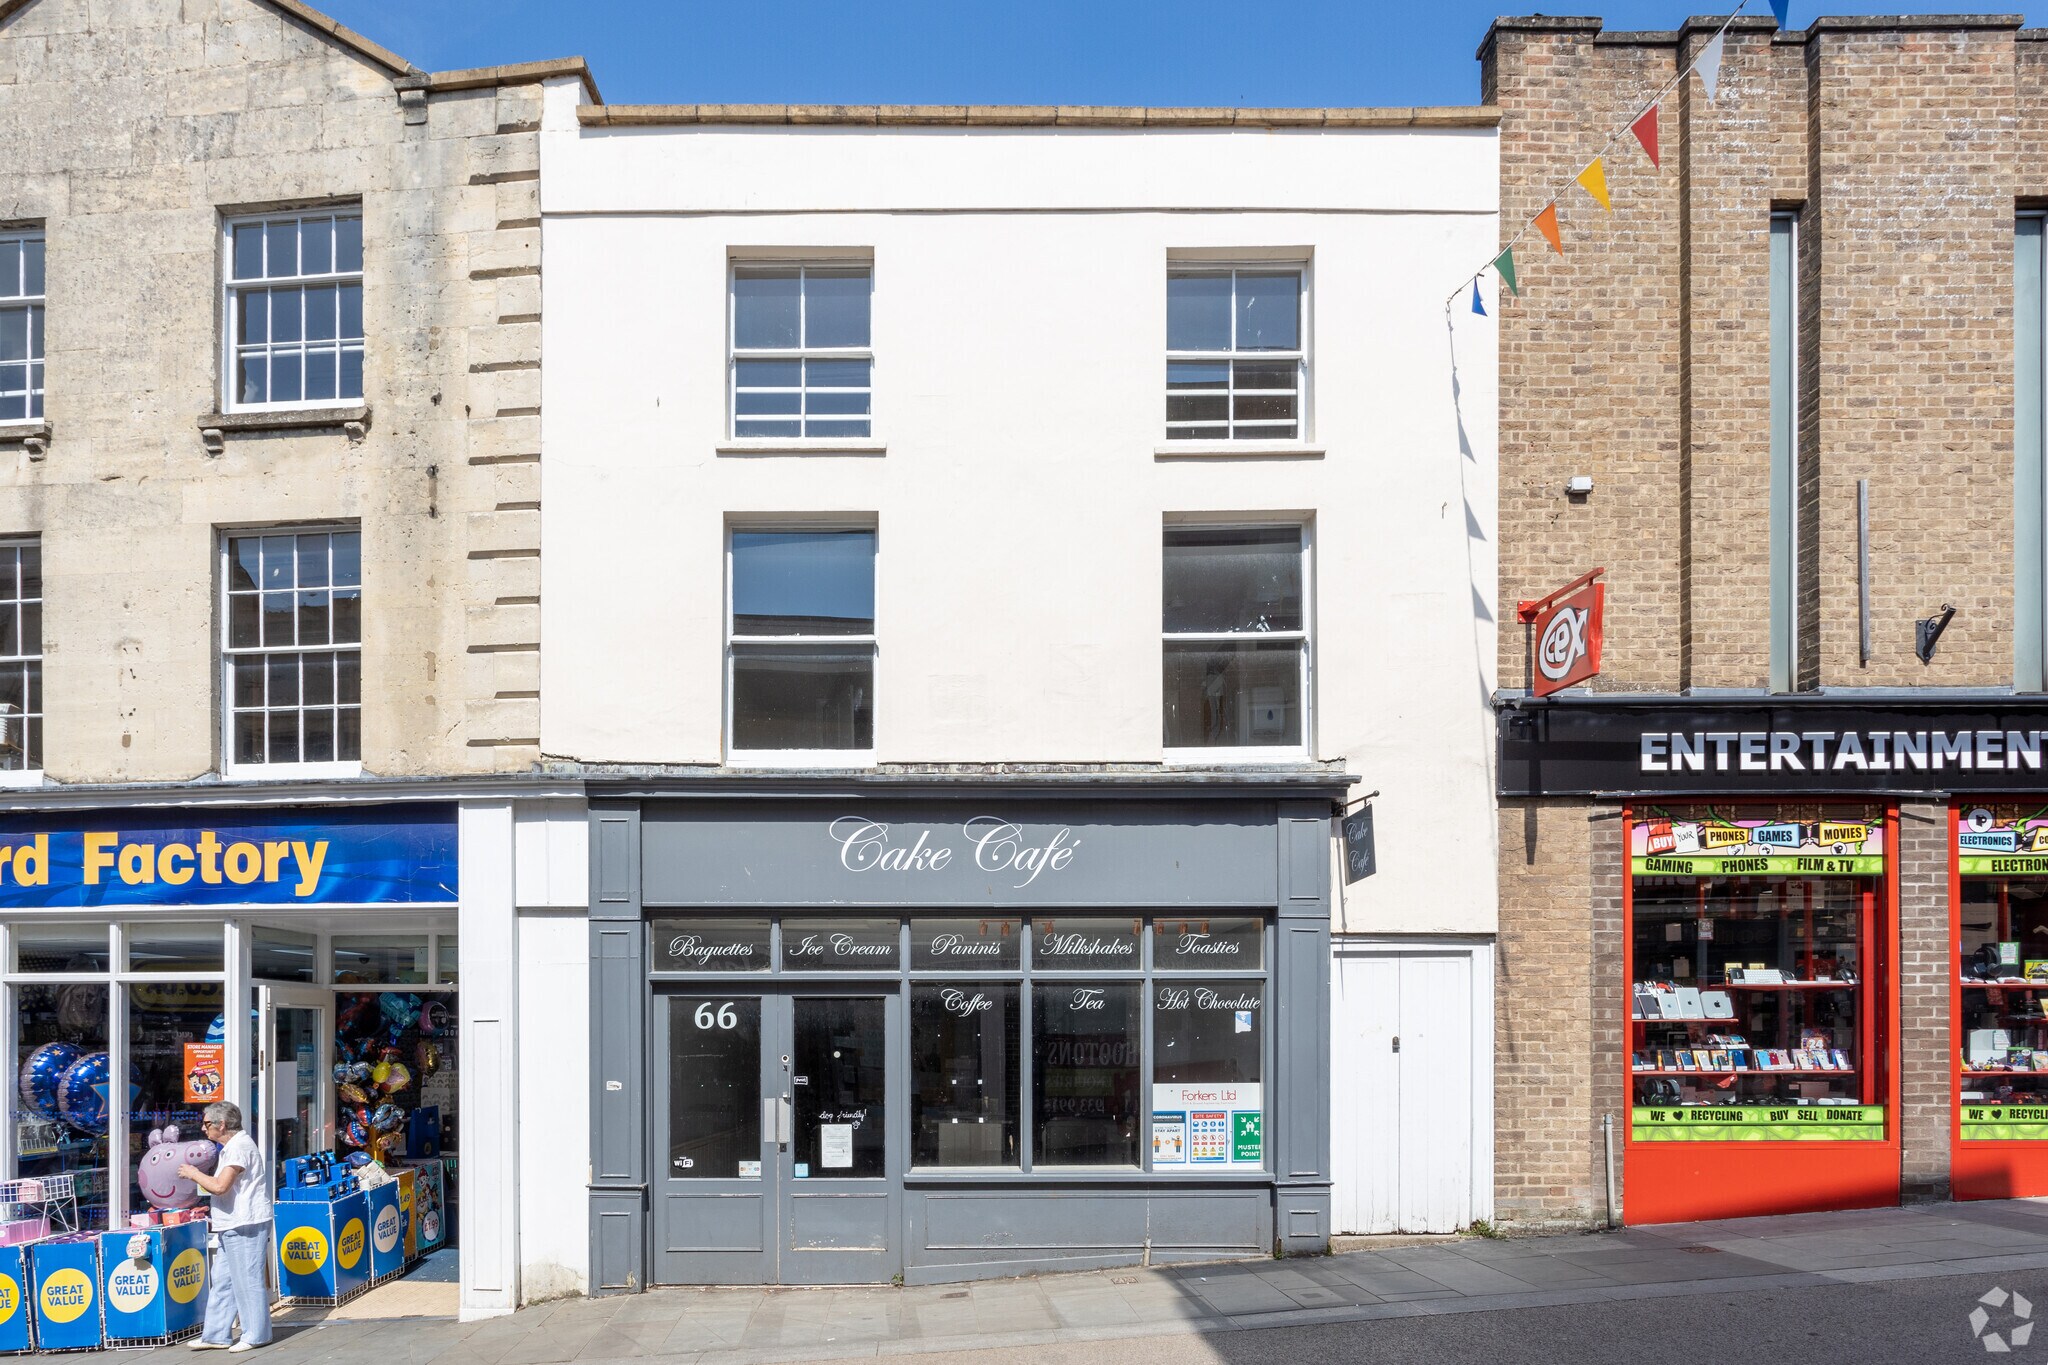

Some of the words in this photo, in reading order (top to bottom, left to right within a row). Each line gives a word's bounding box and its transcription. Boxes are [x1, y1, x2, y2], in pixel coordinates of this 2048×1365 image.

[1641, 731, 2048, 772] ENTERTAINMEN
[1346, 822, 1369, 844] Cake
[1652, 837, 1673, 850] BUY
[1676, 830, 1694, 843] YOUR
[1710, 831, 1746, 843] PHONES
[1758, 830, 1793, 843] GAMES
[1824, 827, 1863, 840] MOVIES
[1960, 835, 2012, 846] ELECTRONICS
[829, 815, 952, 872] Cake
[964, 815, 1081, 888] Café
[83, 831, 329, 897] Factory
[1645, 858, 1694, 874] GAMING
[1721, 857, 1769, 873] PHONES
[1797, 857, 1824, 871] FILM
[1826, 861, 1836, 872] &
[1838, 859, 1855, 873] TV
[1991, 858, 2048, 872] ELECTRON
[668, 934, 753, 965] Baguettes
[789, 933, 823, 956] Ice
[829, 933, 892, 956] Cream
[930, 933, 1001, 955] Paninis
[1040, 932, 1134, 955] Milkshakes
[1175, 933, 1240, 955] Toasties
[940, 988, 993, 1018] Coffee
[1069, 988, 1106, 1010] Tea
[1156, 987, 1189, 1010] Hot
[1194, 987, 1261, 1010] Chocolate
[694, 1001, 738, 1030] 66
[1181, 1089, 1217, 1101] Forkers
[1221, 1089, 1237, 1101] Ltd
[819, 1110, 834, 1123] dog
[1650, 1110, 1665, 1121] WE
[1690, 1110, 1743, 1121] RECYCLING
[1770, 1110, 1789, 1122] BUY
[1797, 1110, 1818, 1121] SELL
[1826, 1109, 1862, 1121] DONATE
[1968, 1109, 1984, 1120] WE
[377, 1216, 396, 1232] GREAT
[341, 1230, 361, 1247] GREAT
[378, 1227, 398, 1241] VALUE
[286, 1241, 320, 1251] GREAT
[342, 1240, 362, 1257] VALUE
[287, 1251, 321, 1261] VALUE
[172, 1262, 200, 1279] GREAT
[114, 1274, 150, 1286] GREAT
[173, 1272, 201, 1289] VALUE
[46, 1284, 84, 1296] GREAT
[115, 1284, 150, 1296] VALUE
[48, 1295, 85, 1307] VALUE
